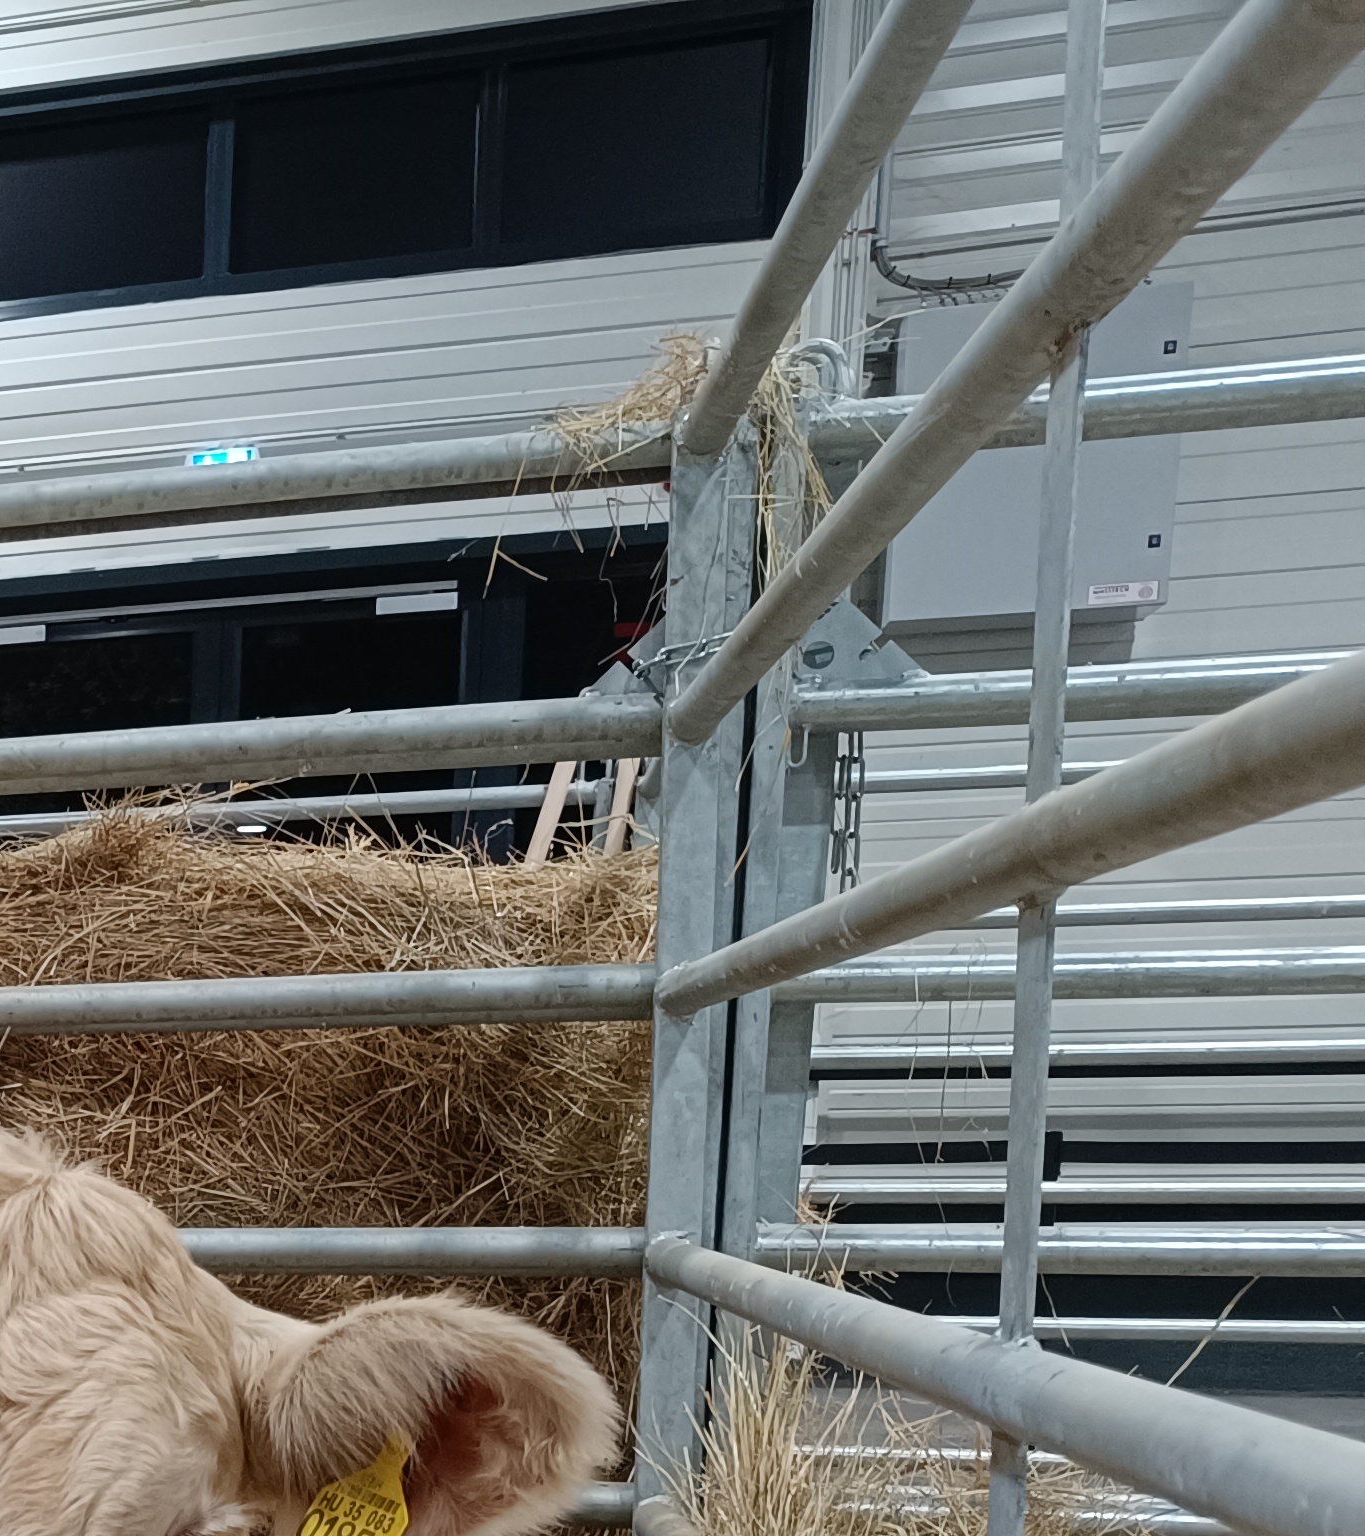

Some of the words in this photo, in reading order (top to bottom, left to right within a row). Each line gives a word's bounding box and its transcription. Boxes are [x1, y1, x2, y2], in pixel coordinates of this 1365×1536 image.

[318, 1491, 345, 1512] HU
[343, 1501, 365, 1521] 35
[365, 1510, 395, 1534] 083
